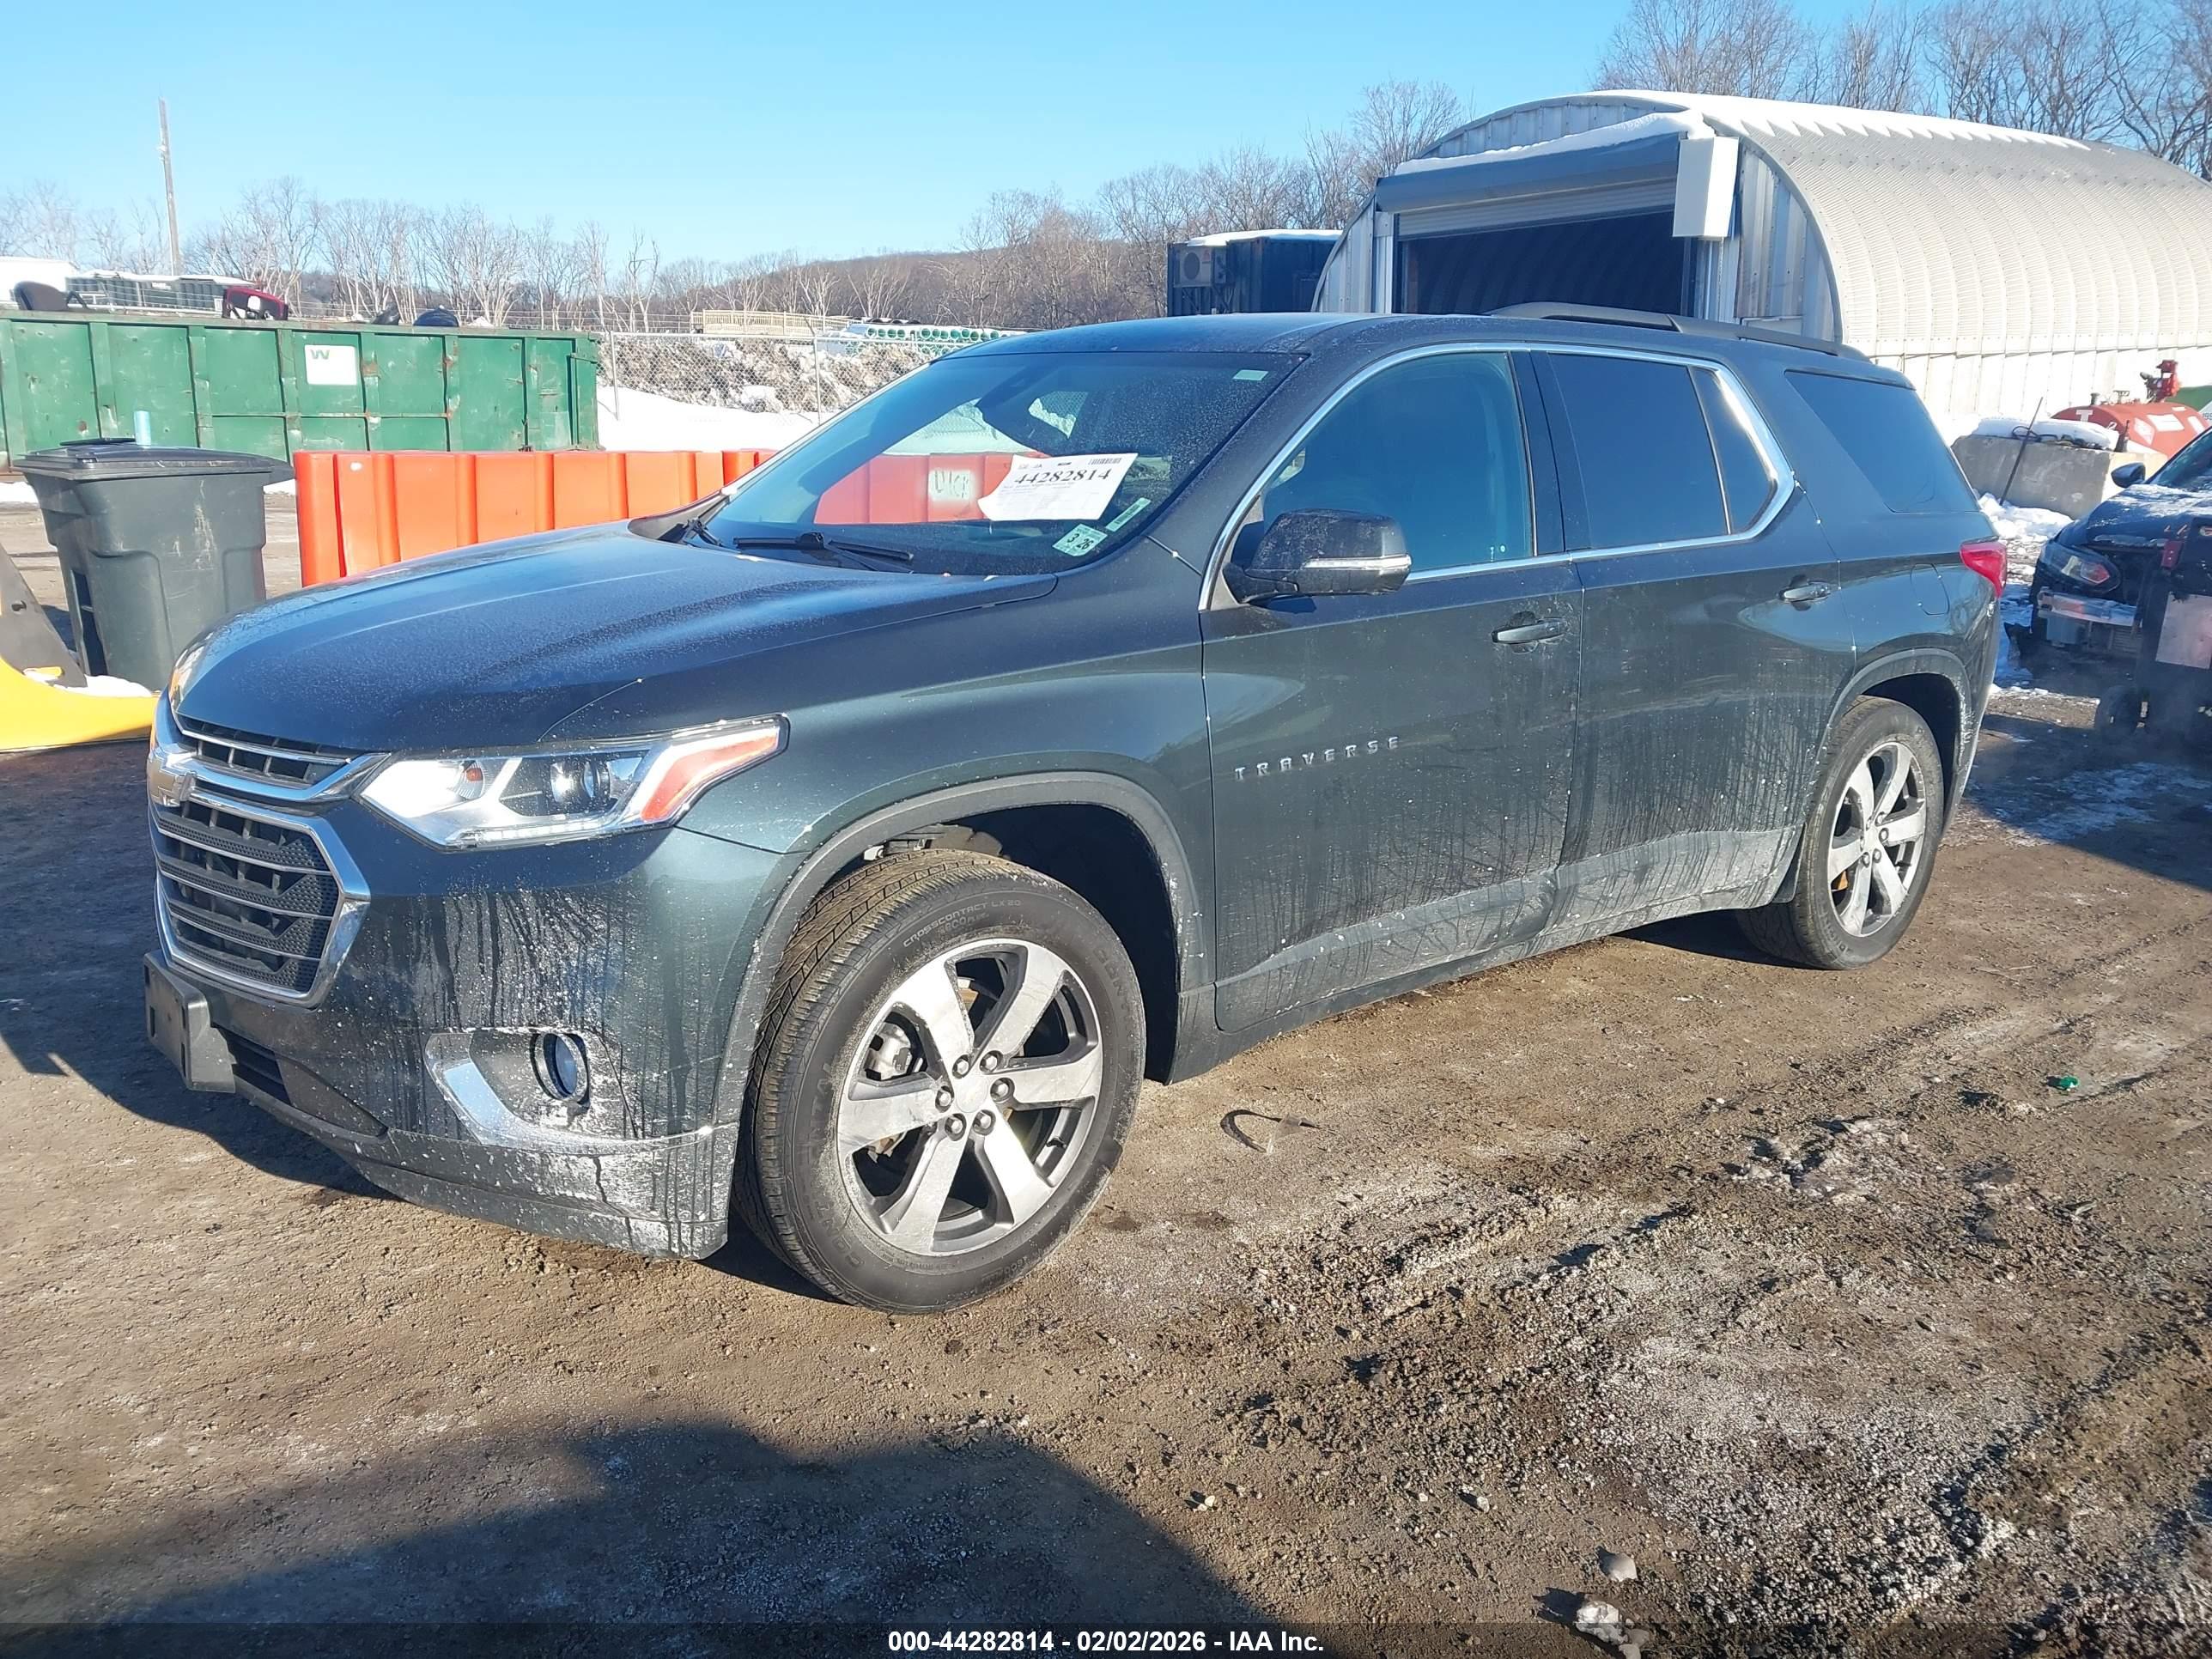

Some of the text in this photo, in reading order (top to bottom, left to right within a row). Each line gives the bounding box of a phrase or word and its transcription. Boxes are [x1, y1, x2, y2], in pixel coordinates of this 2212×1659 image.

[1014, 468, 1113, 484] 44282814
[1066, 532, 1094, 550] 3 26
[1234, 736, 1400, 781] TRAVERSE
